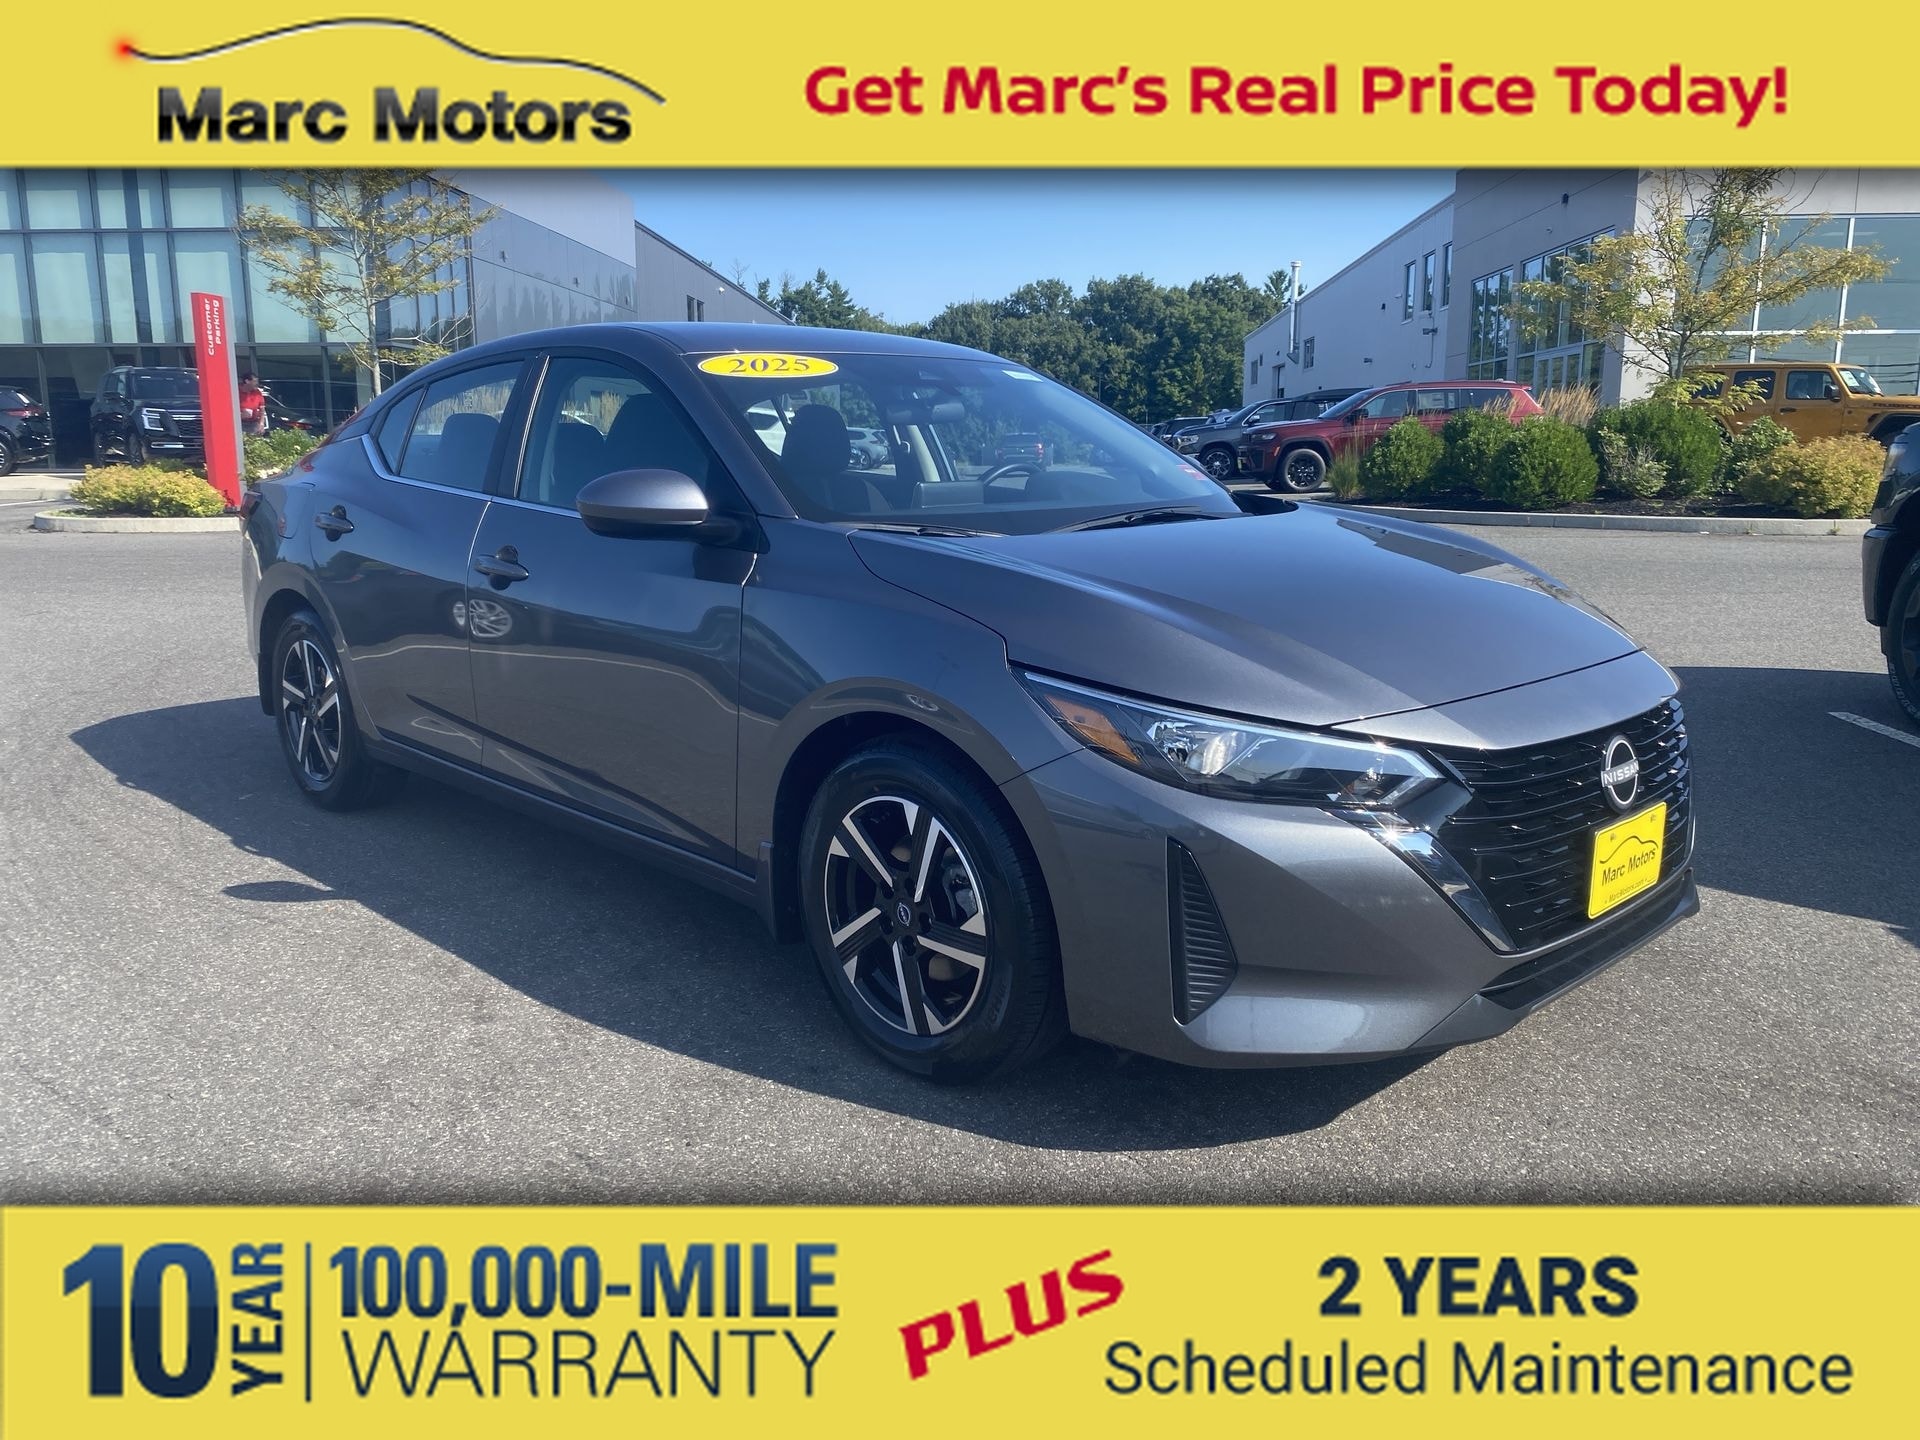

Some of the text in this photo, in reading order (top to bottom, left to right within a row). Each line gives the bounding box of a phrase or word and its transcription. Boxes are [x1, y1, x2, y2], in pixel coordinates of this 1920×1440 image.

[727, 358, 810, 373] 2025
[1603, 761, 1639, 785] NISSAN
[1601, 847, 1656, 887] Marc Motors
